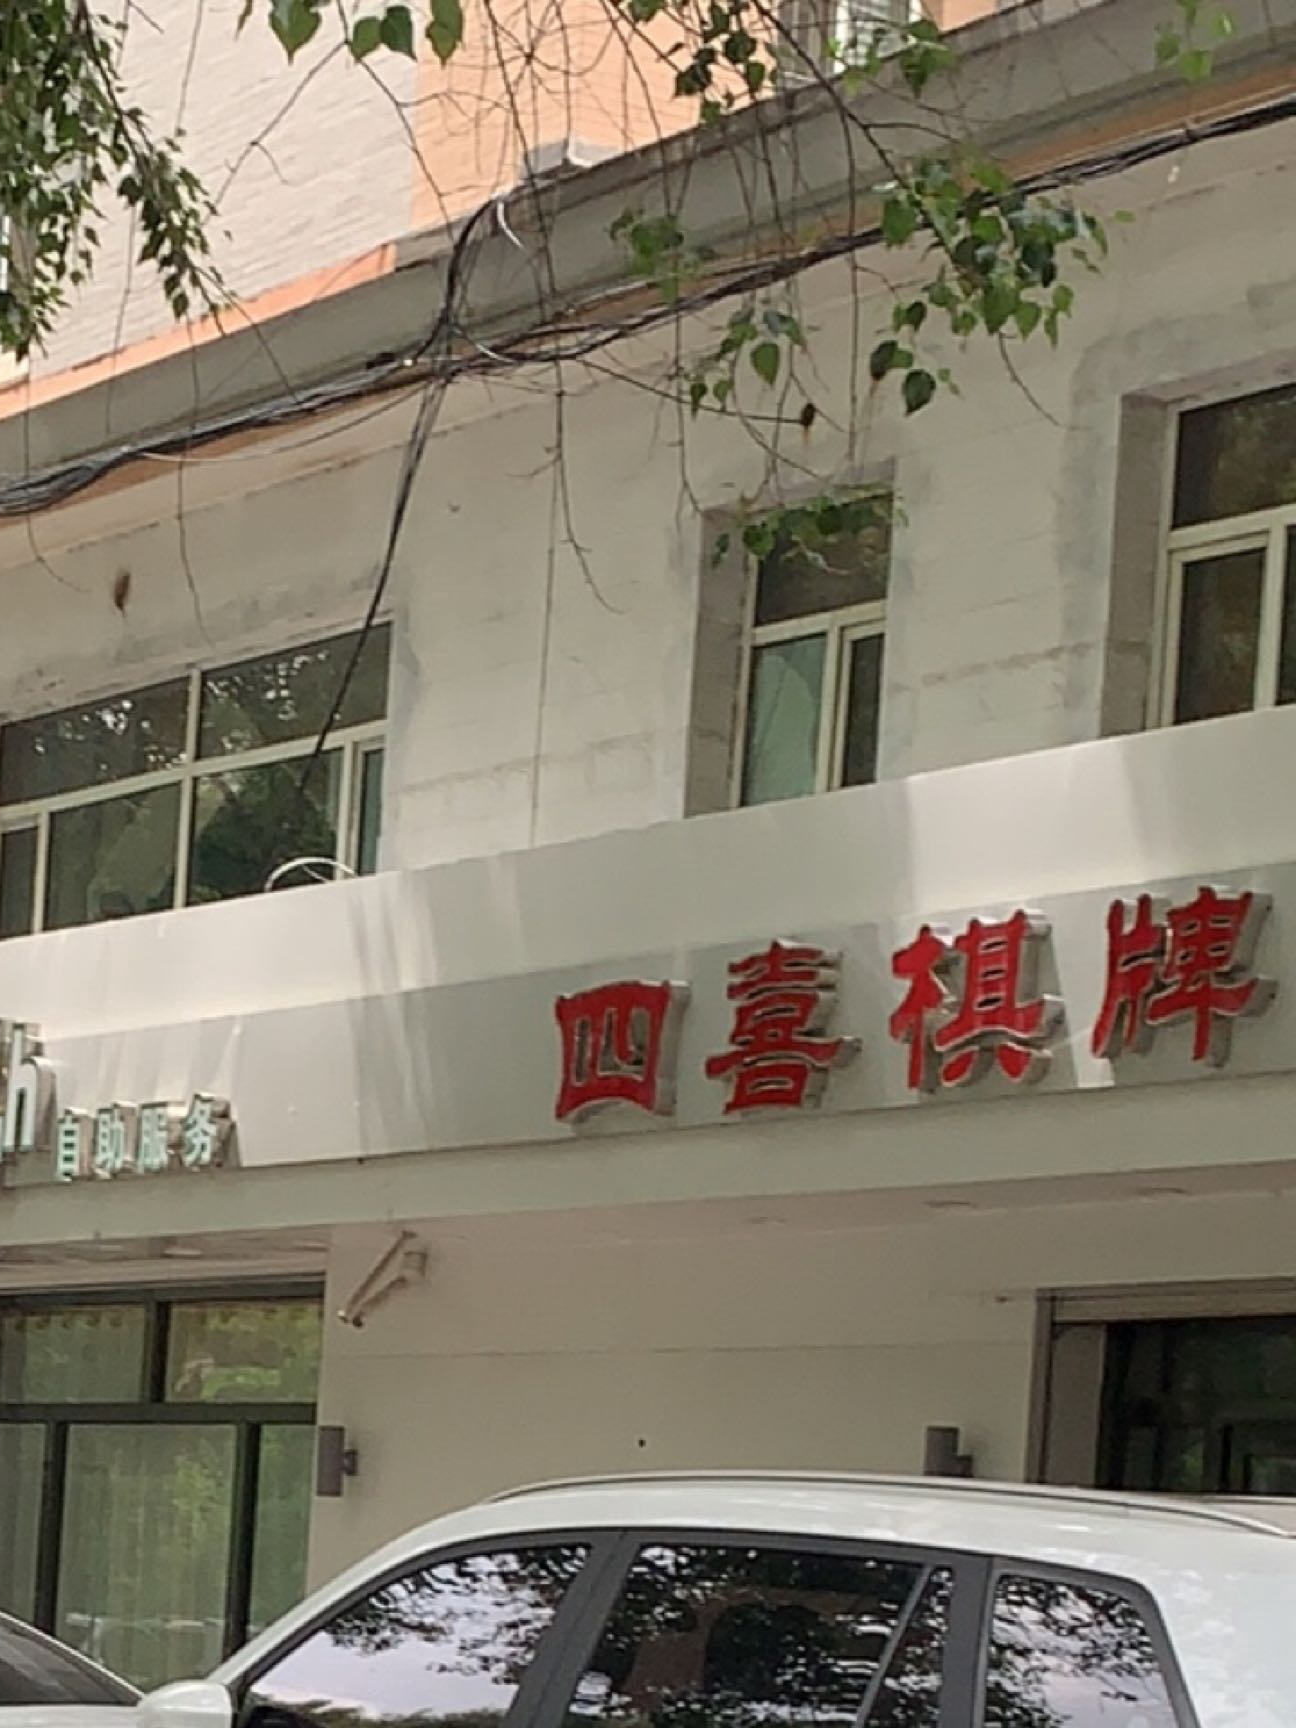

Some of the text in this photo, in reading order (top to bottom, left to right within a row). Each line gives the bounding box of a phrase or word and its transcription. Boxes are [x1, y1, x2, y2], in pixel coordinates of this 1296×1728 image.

[554, 884, 1270, 1124] 四喜棋牌
[56, 1093, 226, 1183] 自助服务
